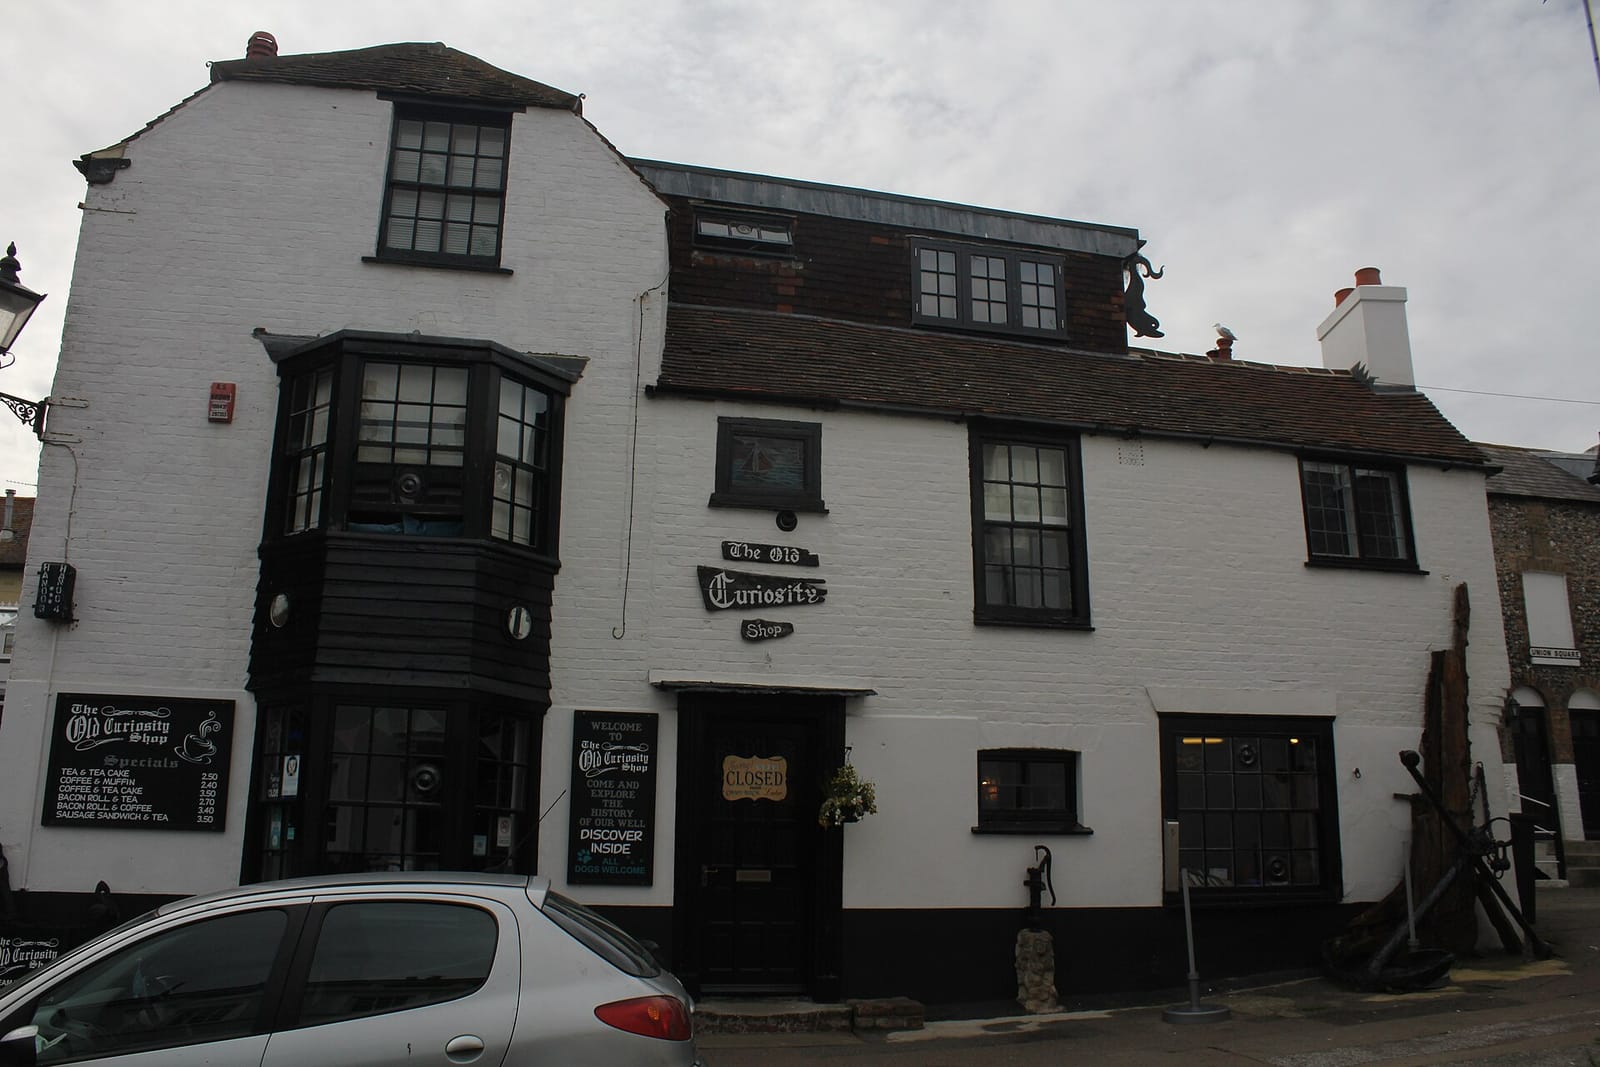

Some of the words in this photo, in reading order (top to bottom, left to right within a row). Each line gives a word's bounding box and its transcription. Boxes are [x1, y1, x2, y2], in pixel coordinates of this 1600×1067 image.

[728, 542, 760, 560] The
[769, 547, 800, 563] Old
[709, 572, 820, 609] Curiosity
[747, 623, 782, 638] Shop
[1554, 650, 1580, 658] SQUARE
[70, 703, 99, 716] The
[65, 715, 101, 743] Old
[103, 717, 171, 735] Curiosity
[591, 721, 643, 732] WELCOME
[128, 732, 168, 745] Shop
[608, 732, 623, 741] TO
[581, 740, 600, 751] The
[103, 754, 179, 769] Specials
[578, 749, 602, 772] Old
[603, 751, 649, 766] Curiosity
[61, 768, 78, 776] TEA
[89, 769, 106, 777] TEA
[107, 769, 130, 777] CAKE
[621, 762, 648, 774] Shop
[59, 776, 93, 784] COFFEE
[102, 777, 136, 786] MUFFIN
[726, 770, 783, 786] CLOSED
[58, 785, 92, 793] COFFEE
[102, 786, 119, 794] TEA
[120, 786, 143, 795] CAKE
[586, 779, 616, 790] COME
[617, 780, 640, 790] AND
[57, 793, 86, 801] BACON
[87, 794, 111, 802] ROLL
[591, 789, 636, 799] EXPLORE
[56, 801, 85, 810] BACON
[86, 803, 110, 811] ROLL
[120, 803, 153, 812] COFFEE
[602, 799, 624, 808] THE
[56, 810, 95, 819] SAUSAGE
[96, 811, 142, 820] SANDWICH
[152, 813, 169, 822] TEA
[591, 808, 634, 818] HISTORY
[579, 817, 593, 827] OF
[594, 817, 615, 827] OUR
[617, 818, 646, 828] WELL
[580, 828, 643, 842] DISCOVER
[591, 842, 632, 855] INSIDE
[602, 857, 618, 866] ALL
[575, 865, 600, 873] DOGS
[601, 865, 646, 875] WELCOME
[0, 936, 11, 947] he
[12, 947, 58, 963] Curiosity
